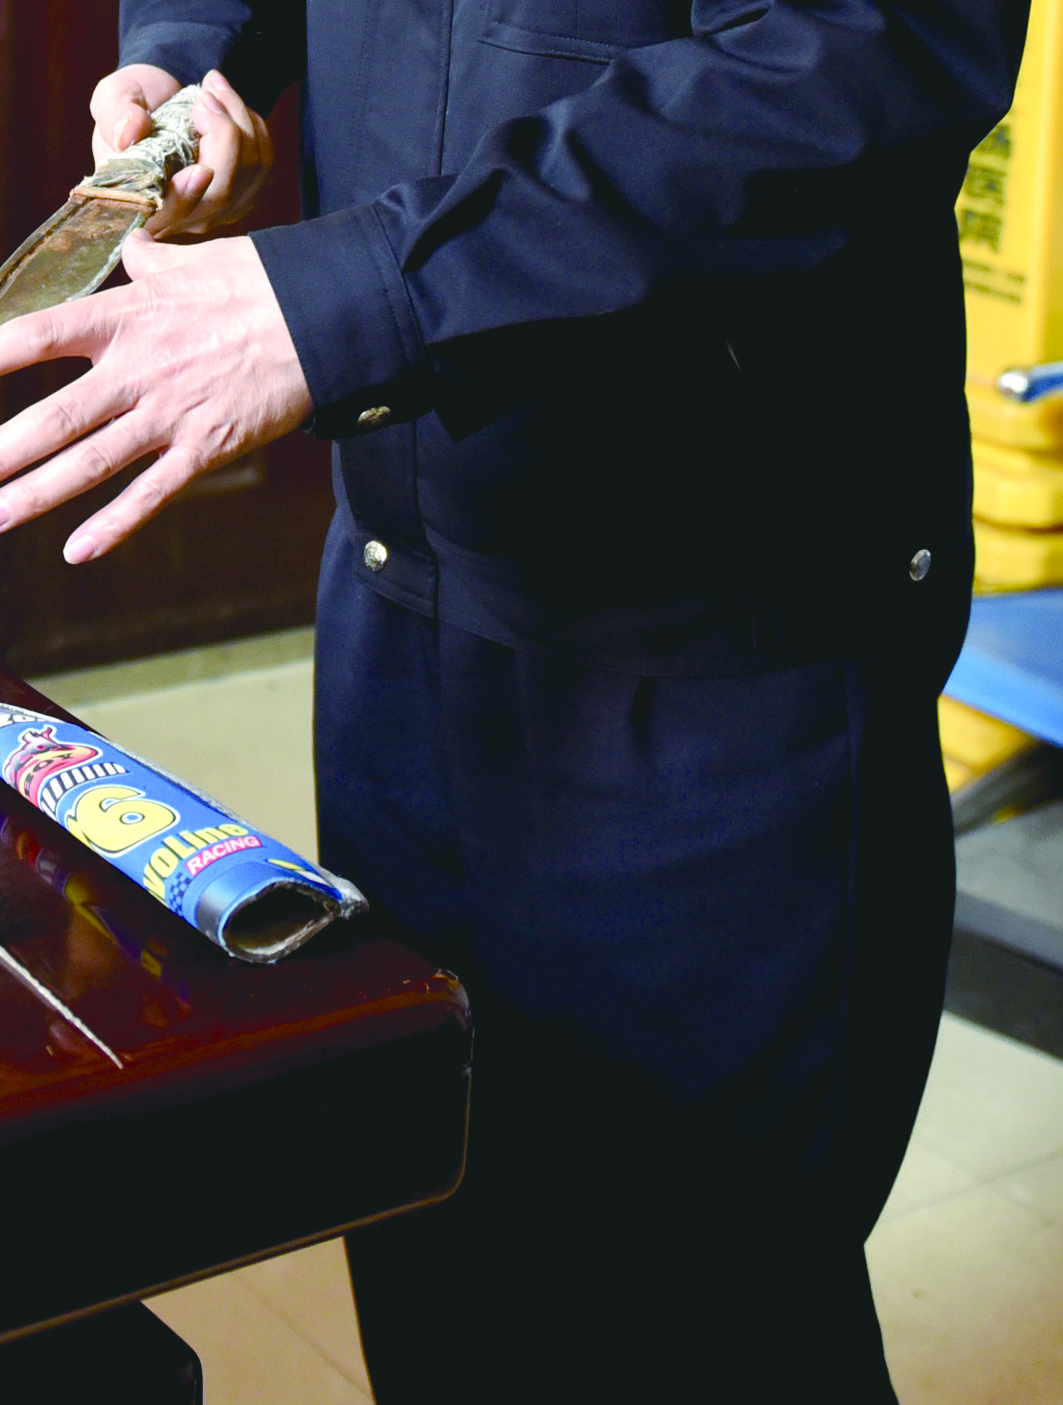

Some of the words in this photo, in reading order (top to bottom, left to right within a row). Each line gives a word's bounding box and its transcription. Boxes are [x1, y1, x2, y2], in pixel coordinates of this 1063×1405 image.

[63, 784, 179, 855] 6
[143, 823, 249, 907] voLine
[187, 836, 261, 876] RACING
